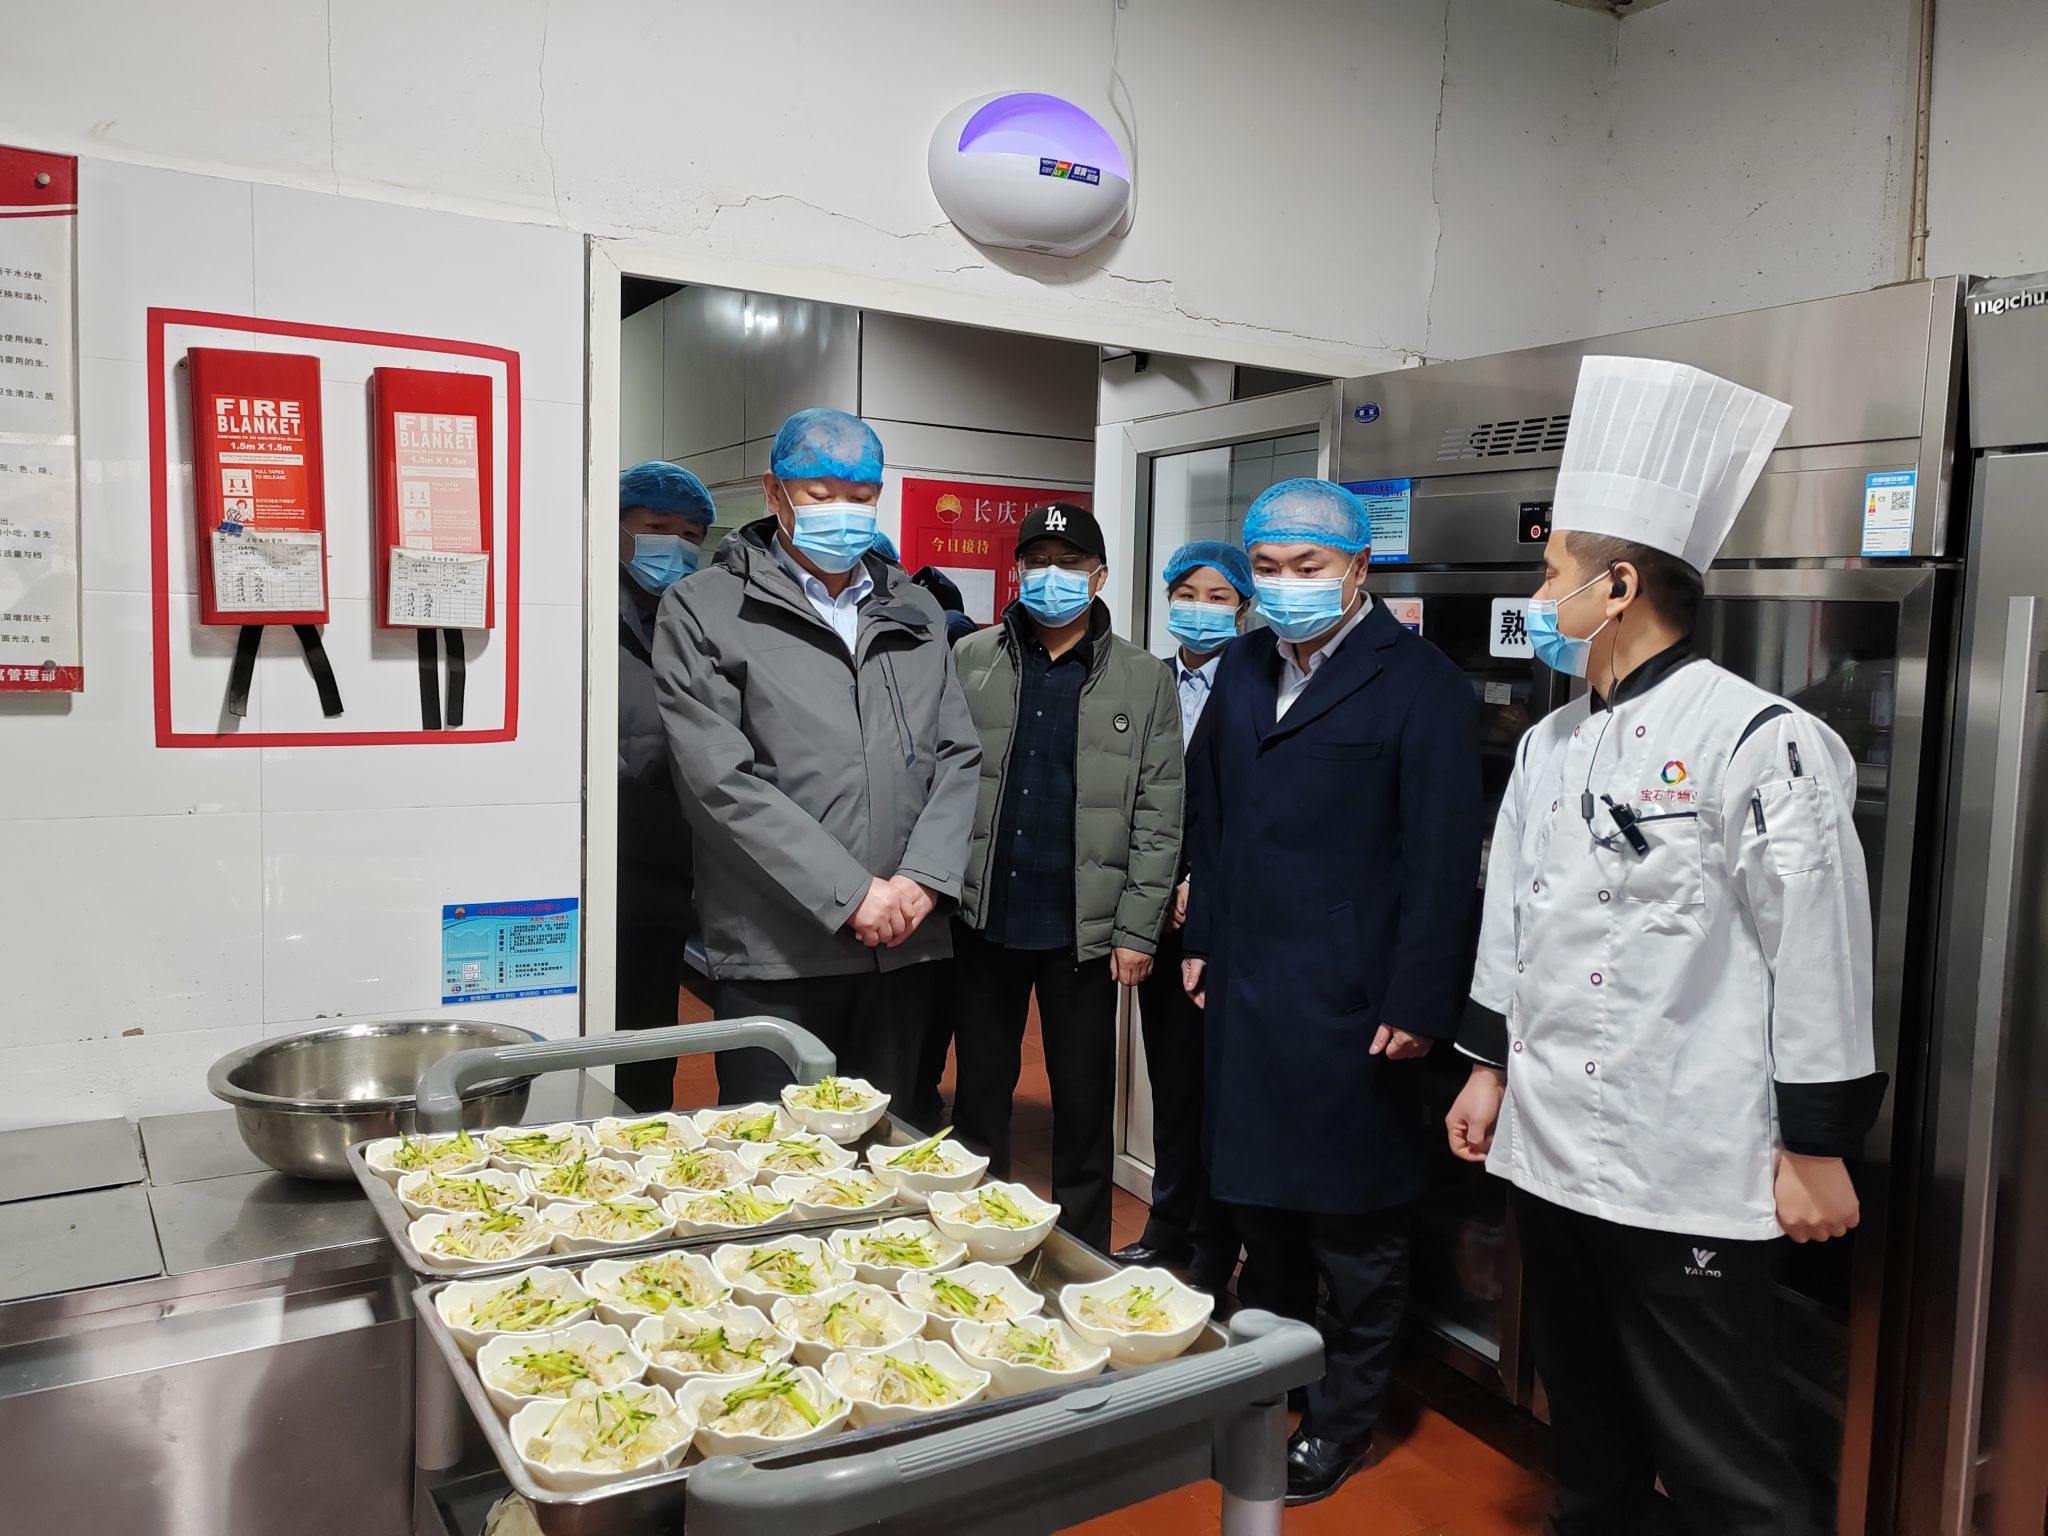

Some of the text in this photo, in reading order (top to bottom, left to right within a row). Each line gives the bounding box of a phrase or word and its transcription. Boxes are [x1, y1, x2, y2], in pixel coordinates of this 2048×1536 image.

[215, 397, 301, 418] FIRE
[217, 415, 301, 436] BLANKET
[399, 415, 475, 433] FIRE
[230, 441, 256, 451] 1.5m
[267, 443, 293, 453] 1.5m
[400, 431, 474, 449] BLANKET
[1045, 506, 1067, 532] LA
[0, 528, 52, 539] 小吃，要先
[0, 549, 42, 559] 质量与档
[931, 536, 990, 555] 今日接待
[1500, 609, 1527, 646] 熟
